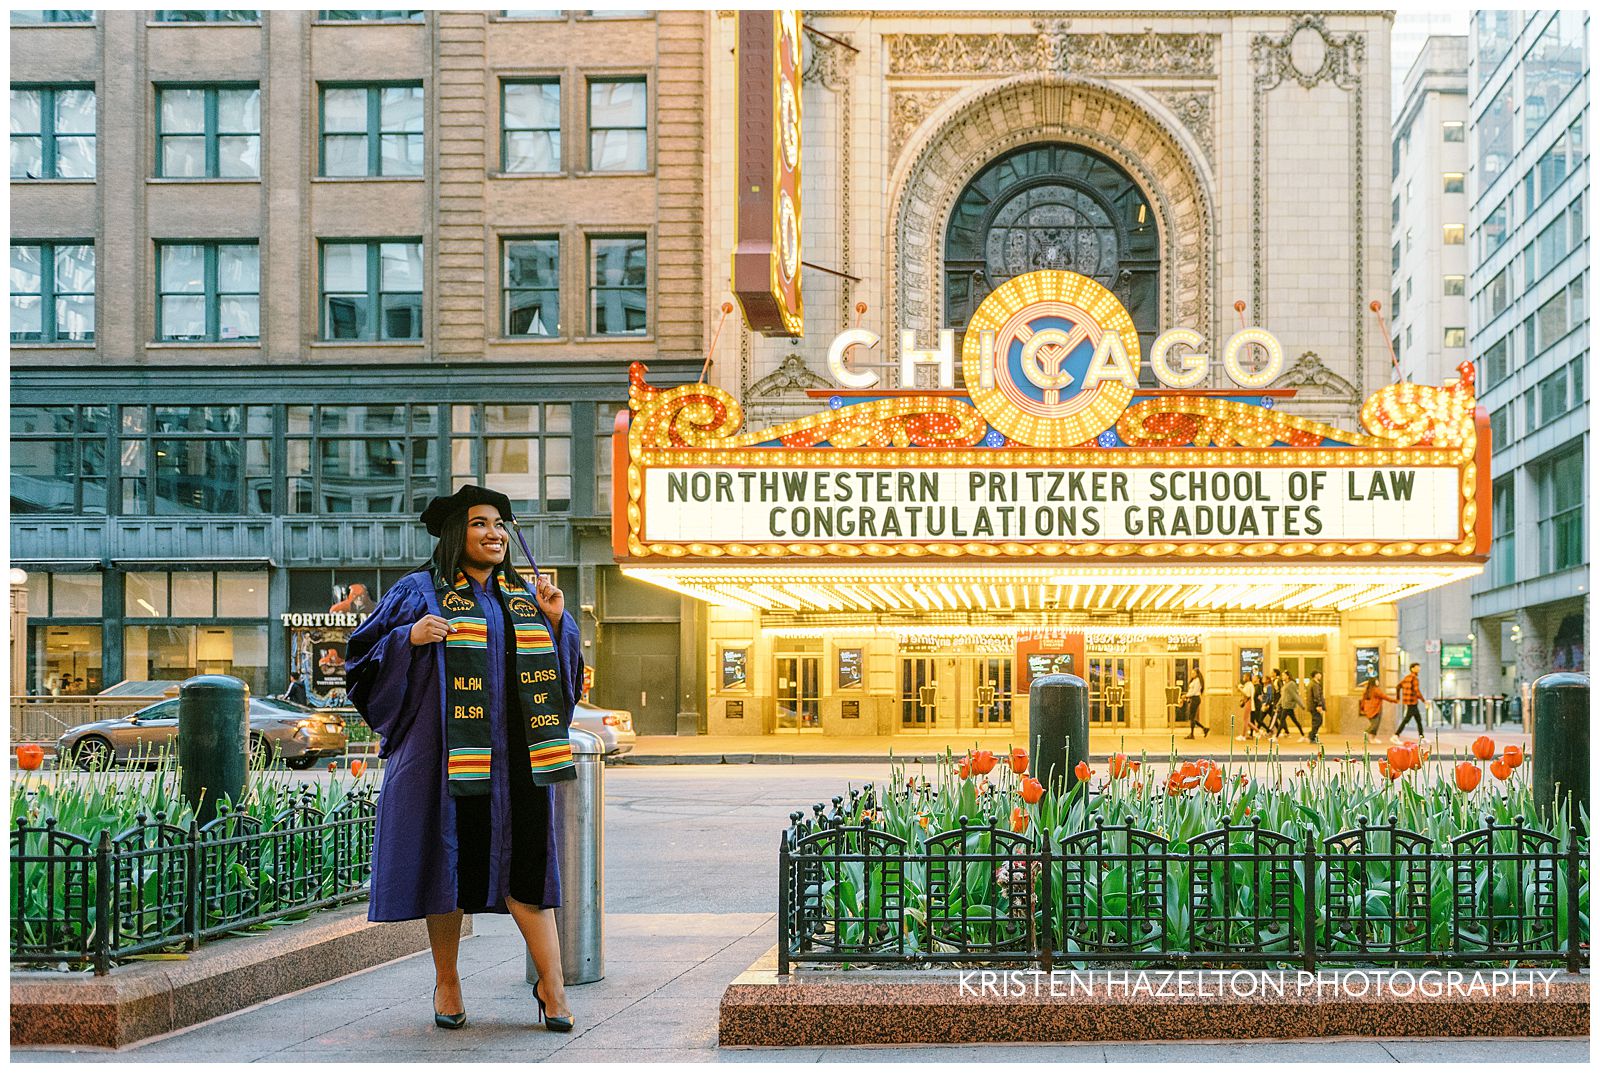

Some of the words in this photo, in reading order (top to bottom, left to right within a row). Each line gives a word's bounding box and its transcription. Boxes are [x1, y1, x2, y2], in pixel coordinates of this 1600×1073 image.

[827, 327, 1285, 390] CHICAGO
[668, 471, 938, 502] NORTHWESTERN
[969, 471, 1129, 502] PRITZKER
[1150, 471, 1271, 501] SCHOOL
[1289, 471, 1327, 501] OF
[1348, 471, 1415, 501] LAW
[769, 506, 1100, 537] CONGRATULATIONS
[1125, 505, 1323, 536] GRADUATES
[281, 613, 357, 626] TORTURE
[520, 669, 556, 684] CLASS
[454, 677, 482, 691] NLAW
[534, 692, 549, 704] OF
[454, 706, 483, 719] BLSA
[530, 714, 560, 728] 2025
